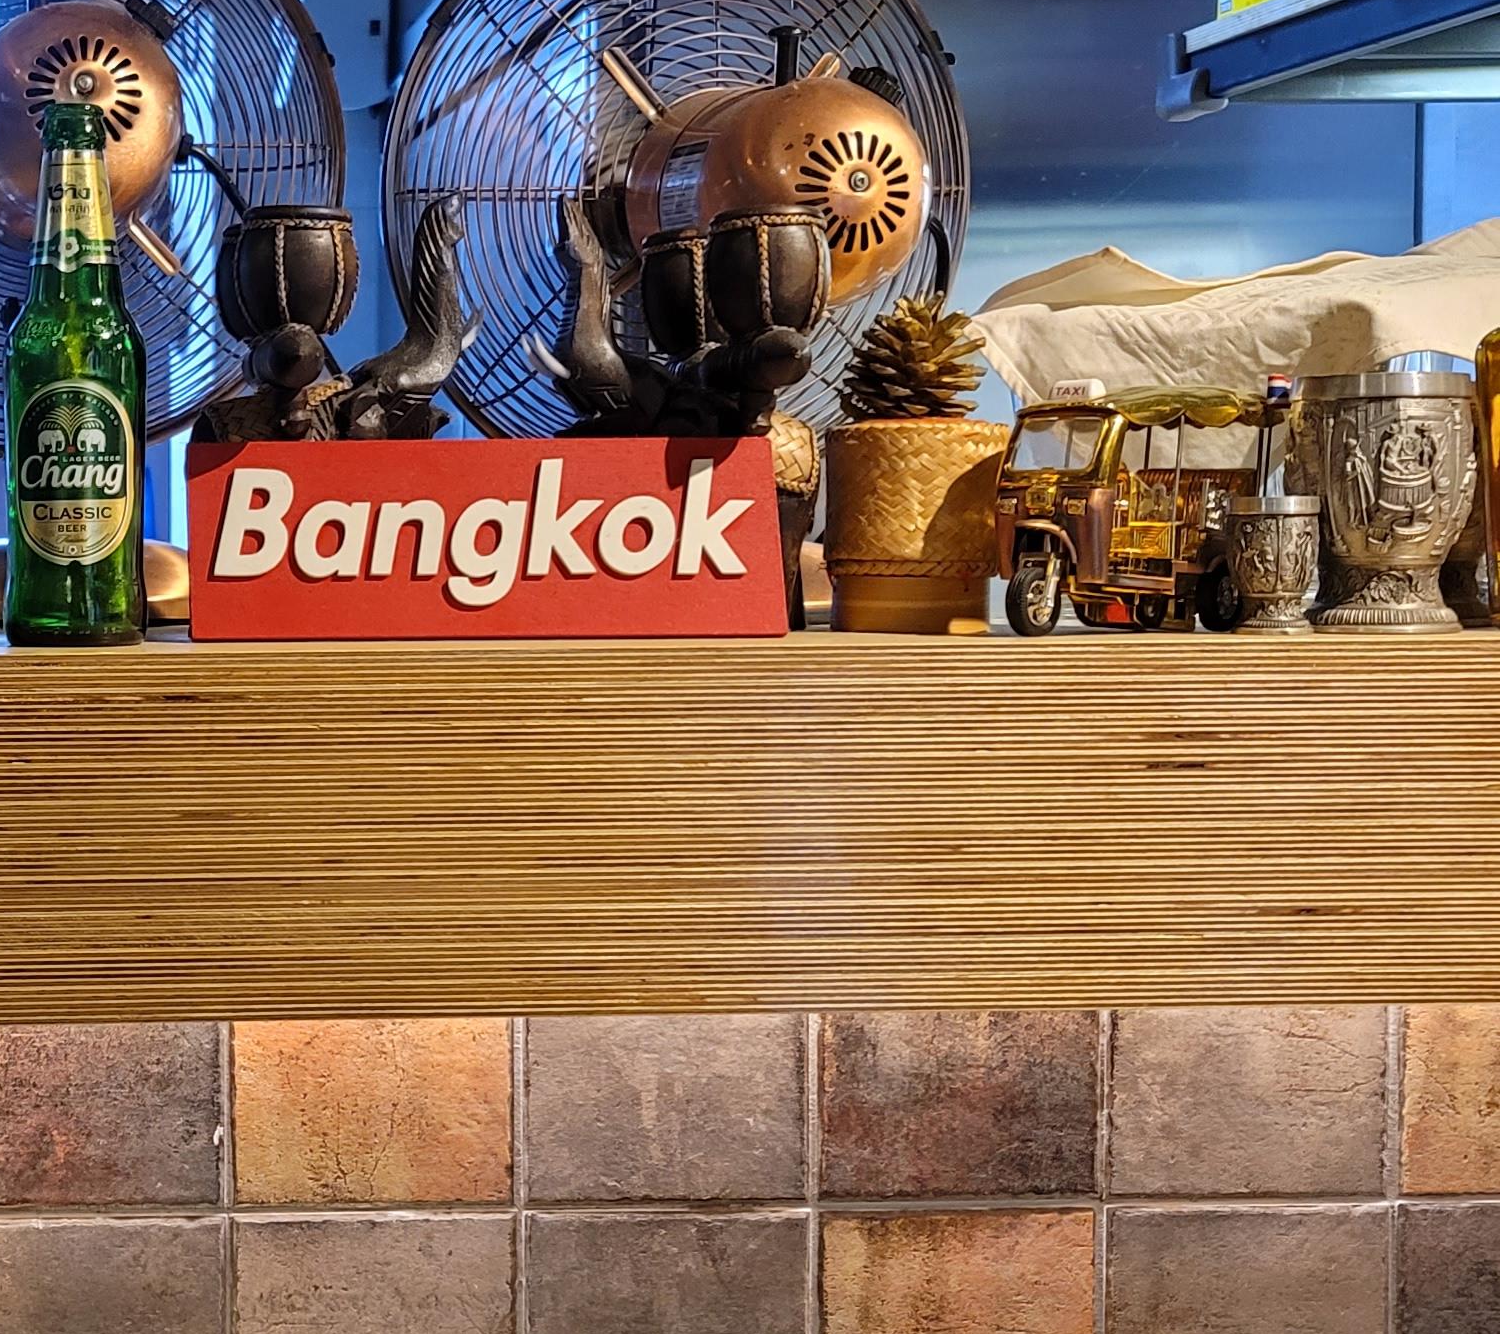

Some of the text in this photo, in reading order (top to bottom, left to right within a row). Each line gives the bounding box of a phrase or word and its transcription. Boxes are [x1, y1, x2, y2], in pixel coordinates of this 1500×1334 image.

[1055, 386, 1086, 396] TAXI
[62, 455, 95, 463] LAGER
[20, 455, 124, 496] Chang
[57, 524, 87, 533] BEER
[213, 458, 754, 607] Bangkok
